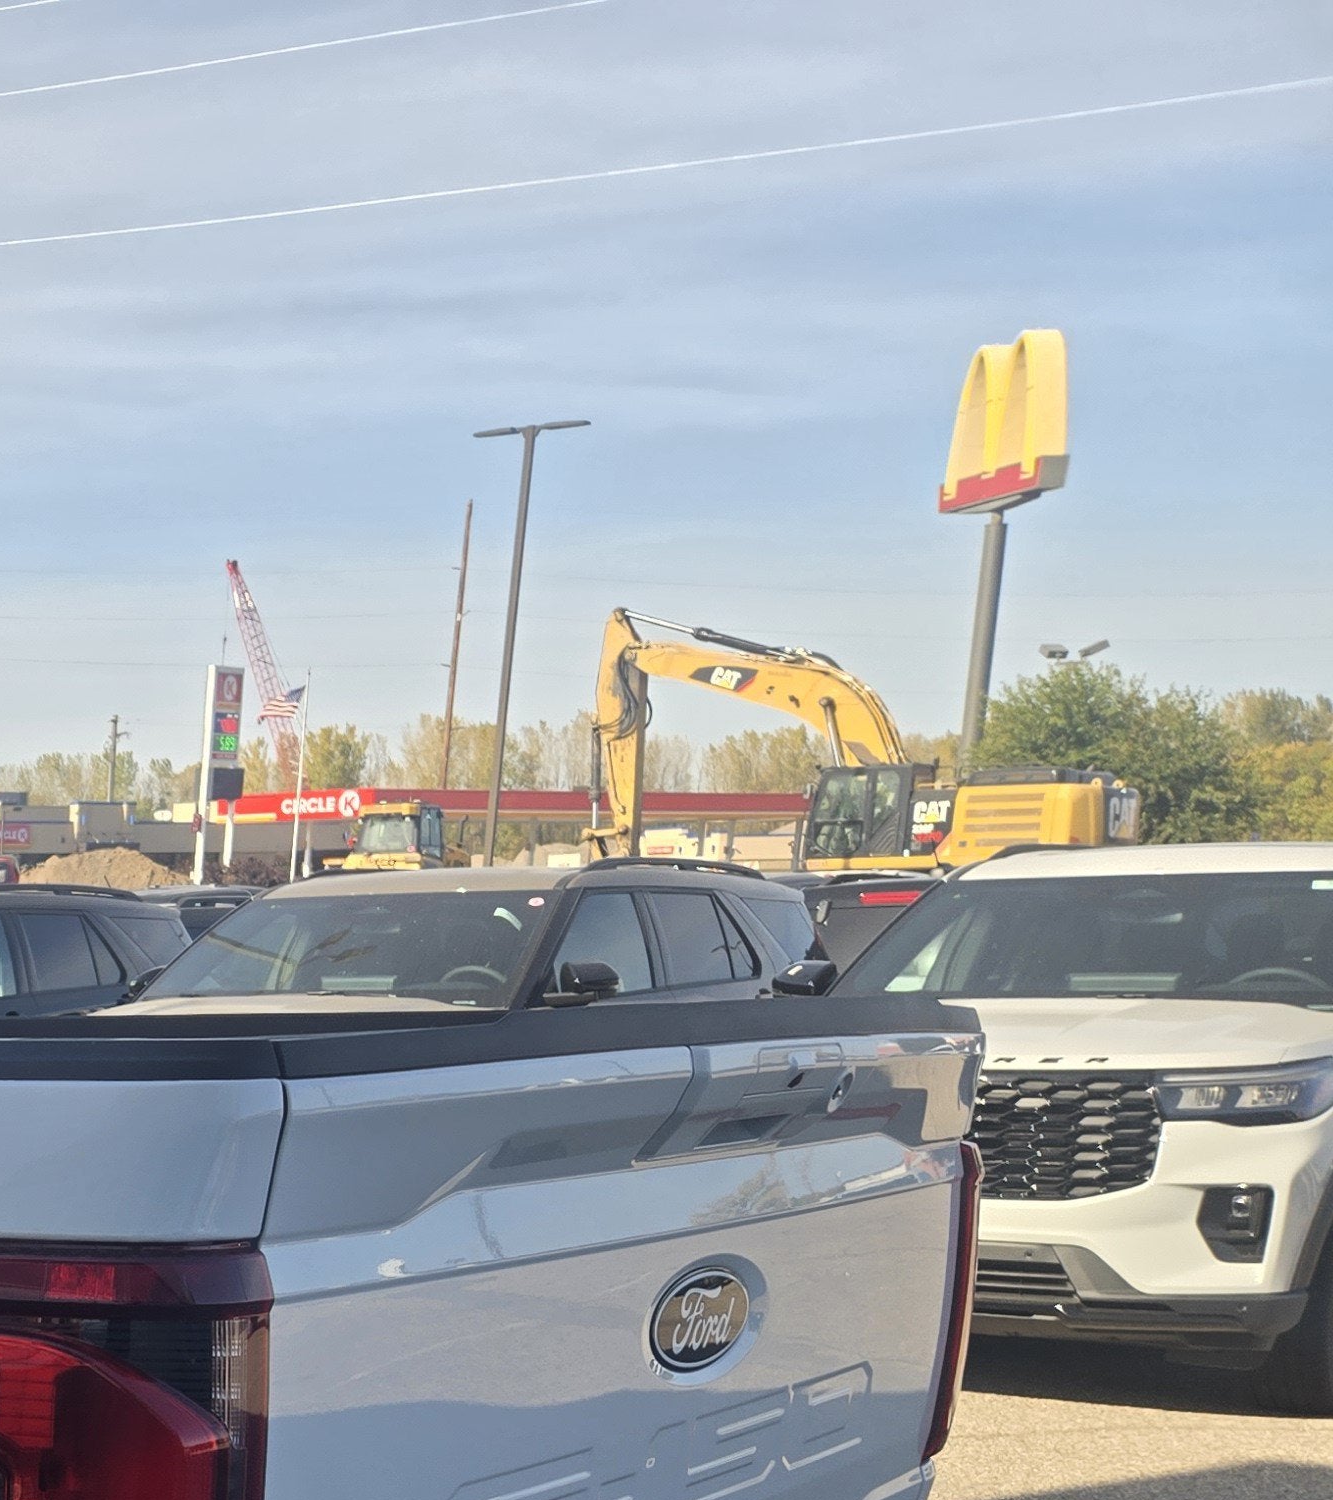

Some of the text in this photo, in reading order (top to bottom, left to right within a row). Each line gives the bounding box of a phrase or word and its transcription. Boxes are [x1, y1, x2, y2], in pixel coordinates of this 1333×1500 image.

[710, 666, 742, 689] CAT
[280, 796, 336, 815] CIRCLE
[913, 800, 951, 823] CAT
[1109, 797, 1137, 839] CAT
[672, 1285, 735, 1355] Ford
